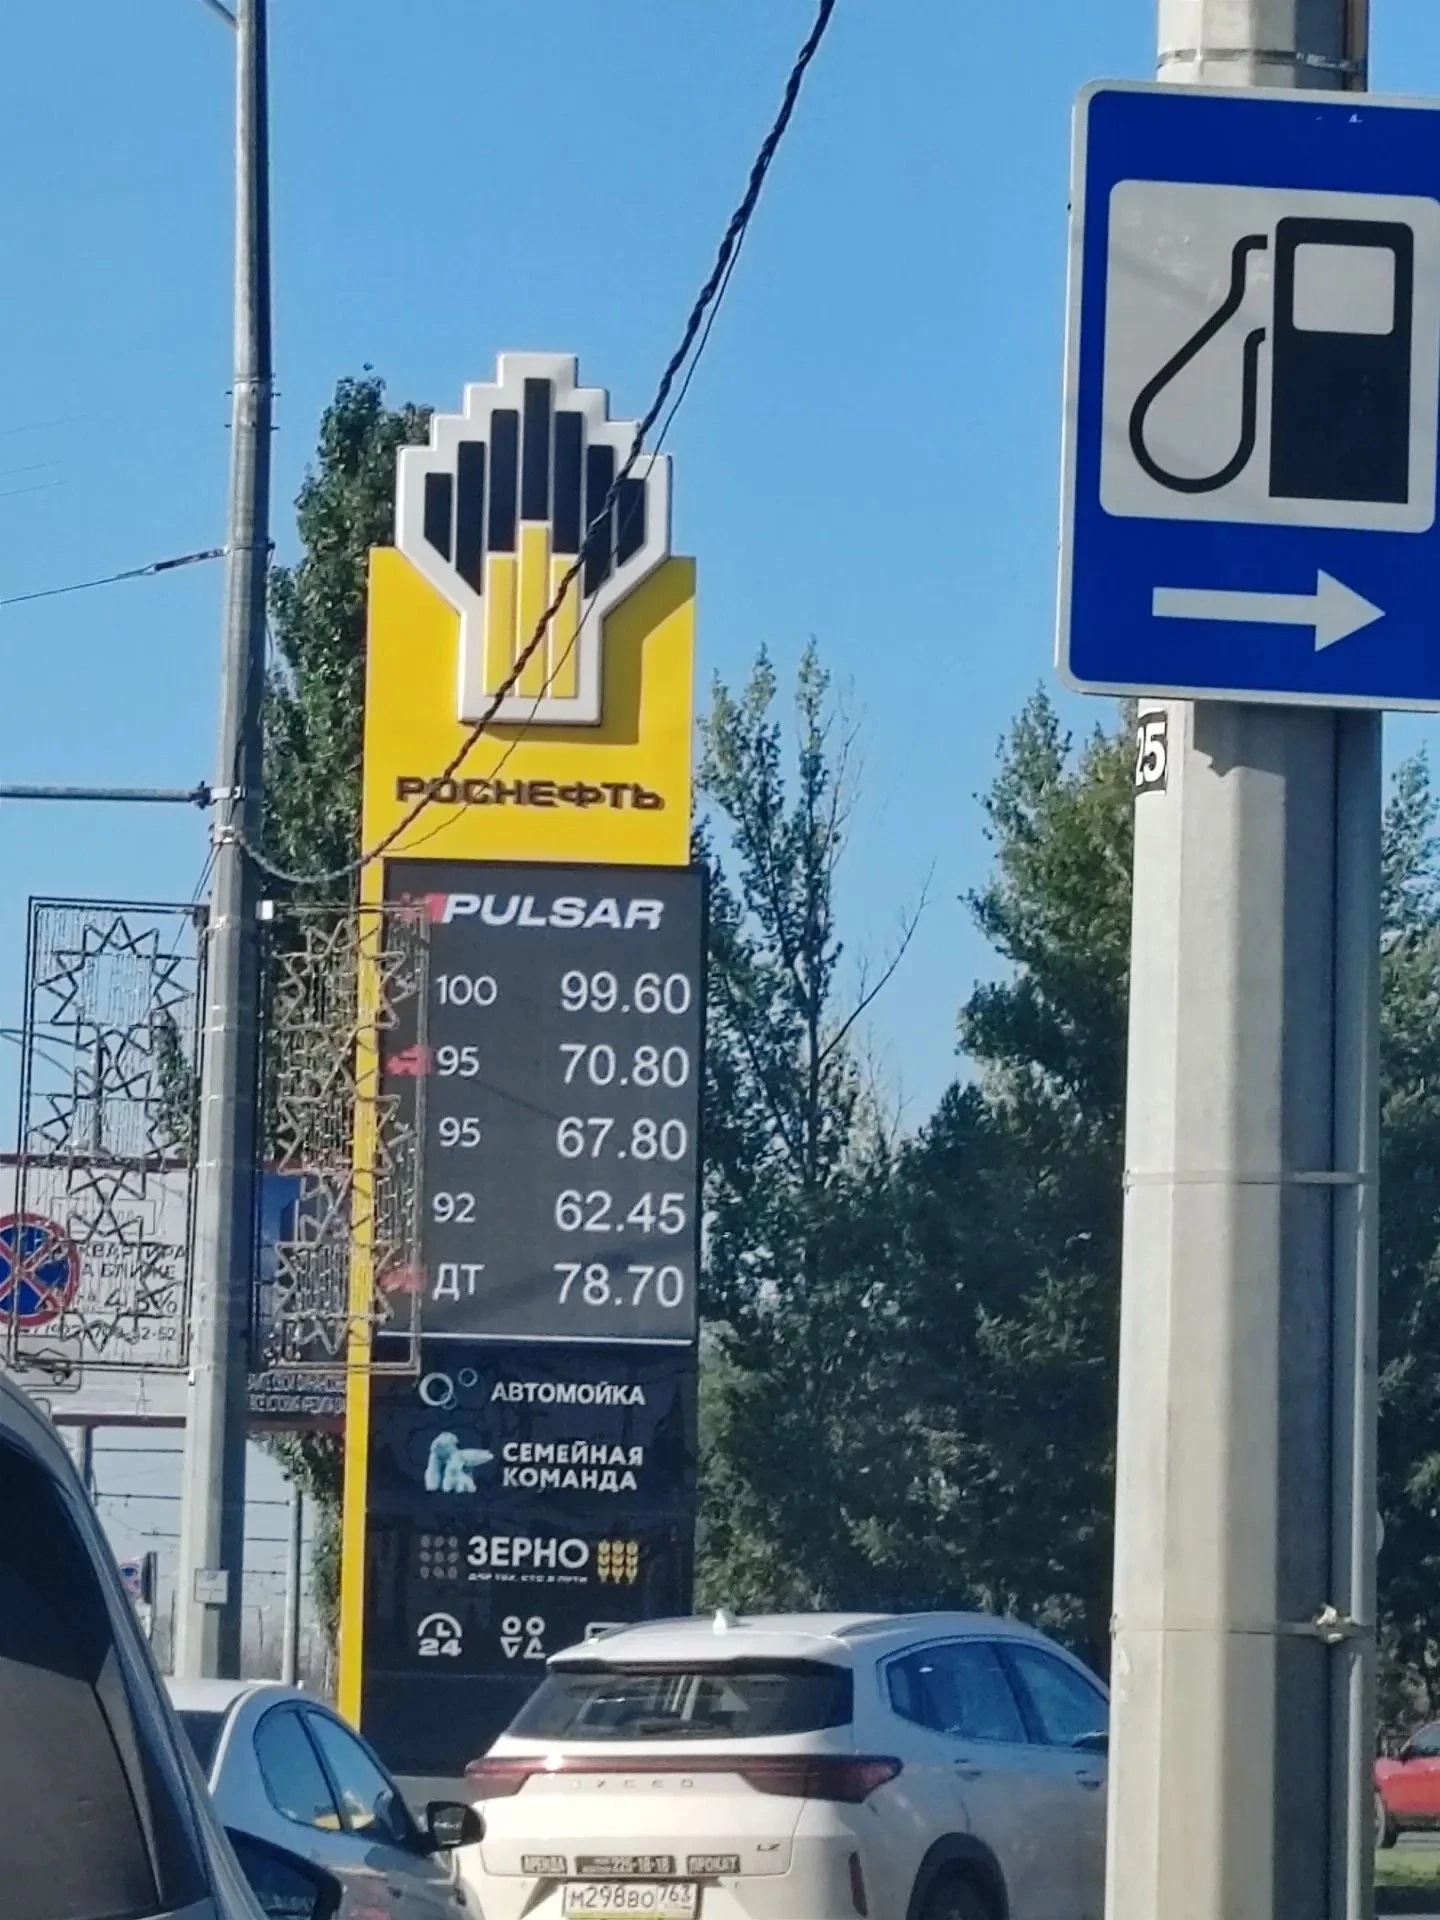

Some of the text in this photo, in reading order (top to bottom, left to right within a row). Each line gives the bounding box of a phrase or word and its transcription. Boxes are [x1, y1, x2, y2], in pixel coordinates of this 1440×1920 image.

[1135, 722, 1166, 786] 25
[395, 776, 665, 810] РОСНЕФТЬ
[442, 893, 664, 930] PULSAR
[435, 970, 692, 1014] 100 99.60
[436, 1044, 690, 1087] 95 70.80
[438, 1116, 688, 1161] 95 67.80
[432, 1190, 686, 1234] 92 62.45
[432, 1263, 684, 1307] ДТ 78.70
[491, 1381, 646, 1406] АВТОМОЙКА
[502, 1441, 643, 1466] СЕМЕЙНАЯ
[502, 1467, 638, 1491] КОМАНДА
[467, 1535, 589, 1569] ЗЕРНО
[418, 1637, 462, 1656] 24
